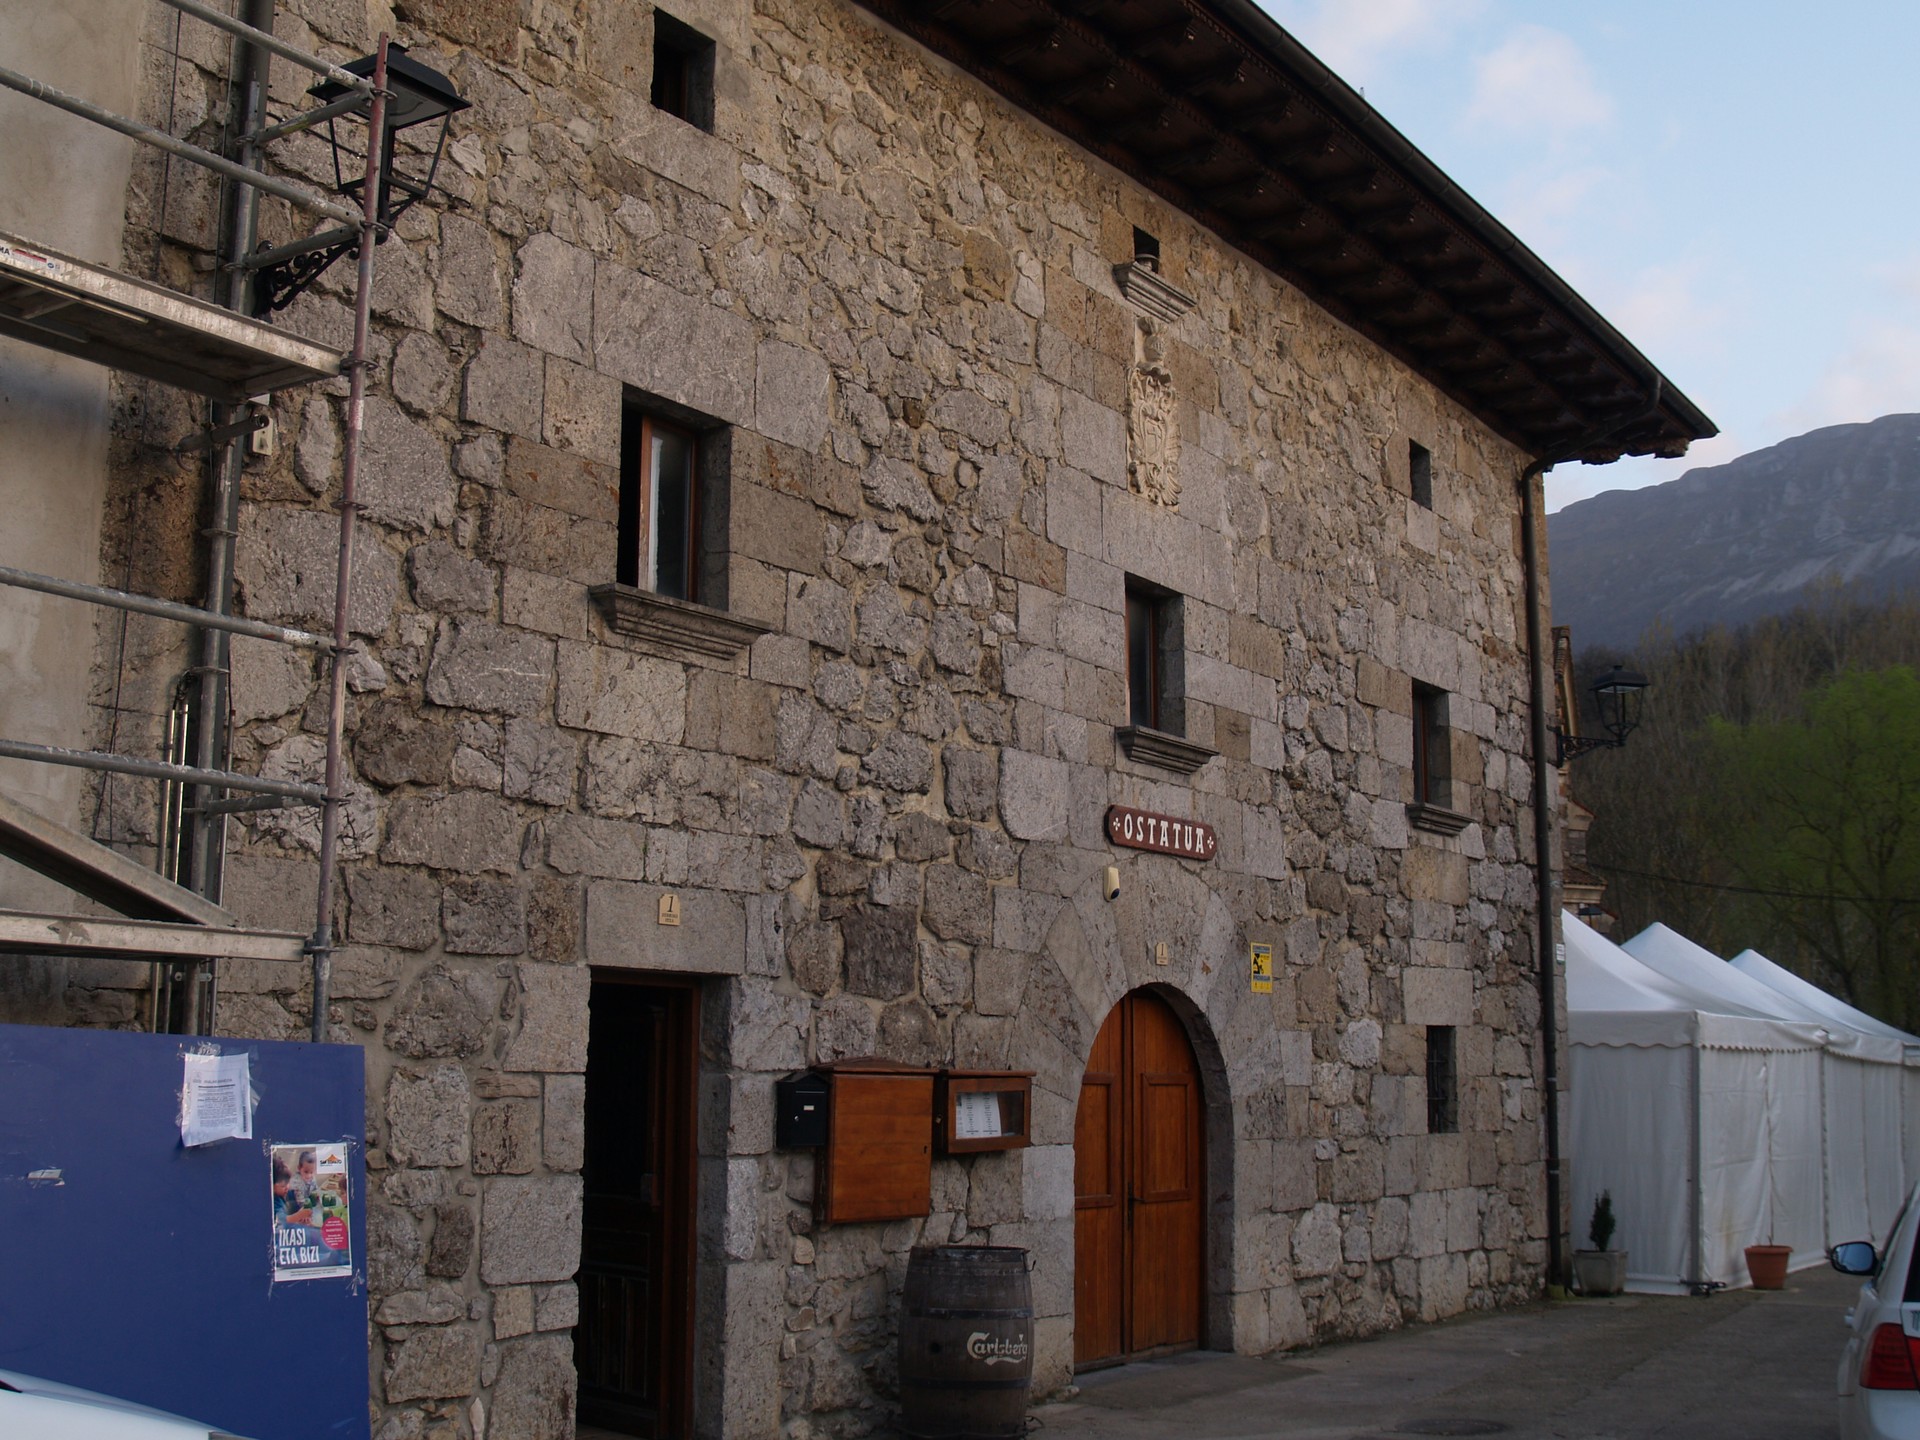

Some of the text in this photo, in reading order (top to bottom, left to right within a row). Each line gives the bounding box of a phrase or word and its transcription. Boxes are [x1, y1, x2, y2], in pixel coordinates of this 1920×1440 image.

[1124, 813, 1205, 854] OSTATUA
[667, 895, 674, 913] 1
[279, 1228, 306, 1247] IKASI
[280, 1245, 320, 1266] ETA BIZI
[967, 1331, 1028, 1365] Carlsberg
